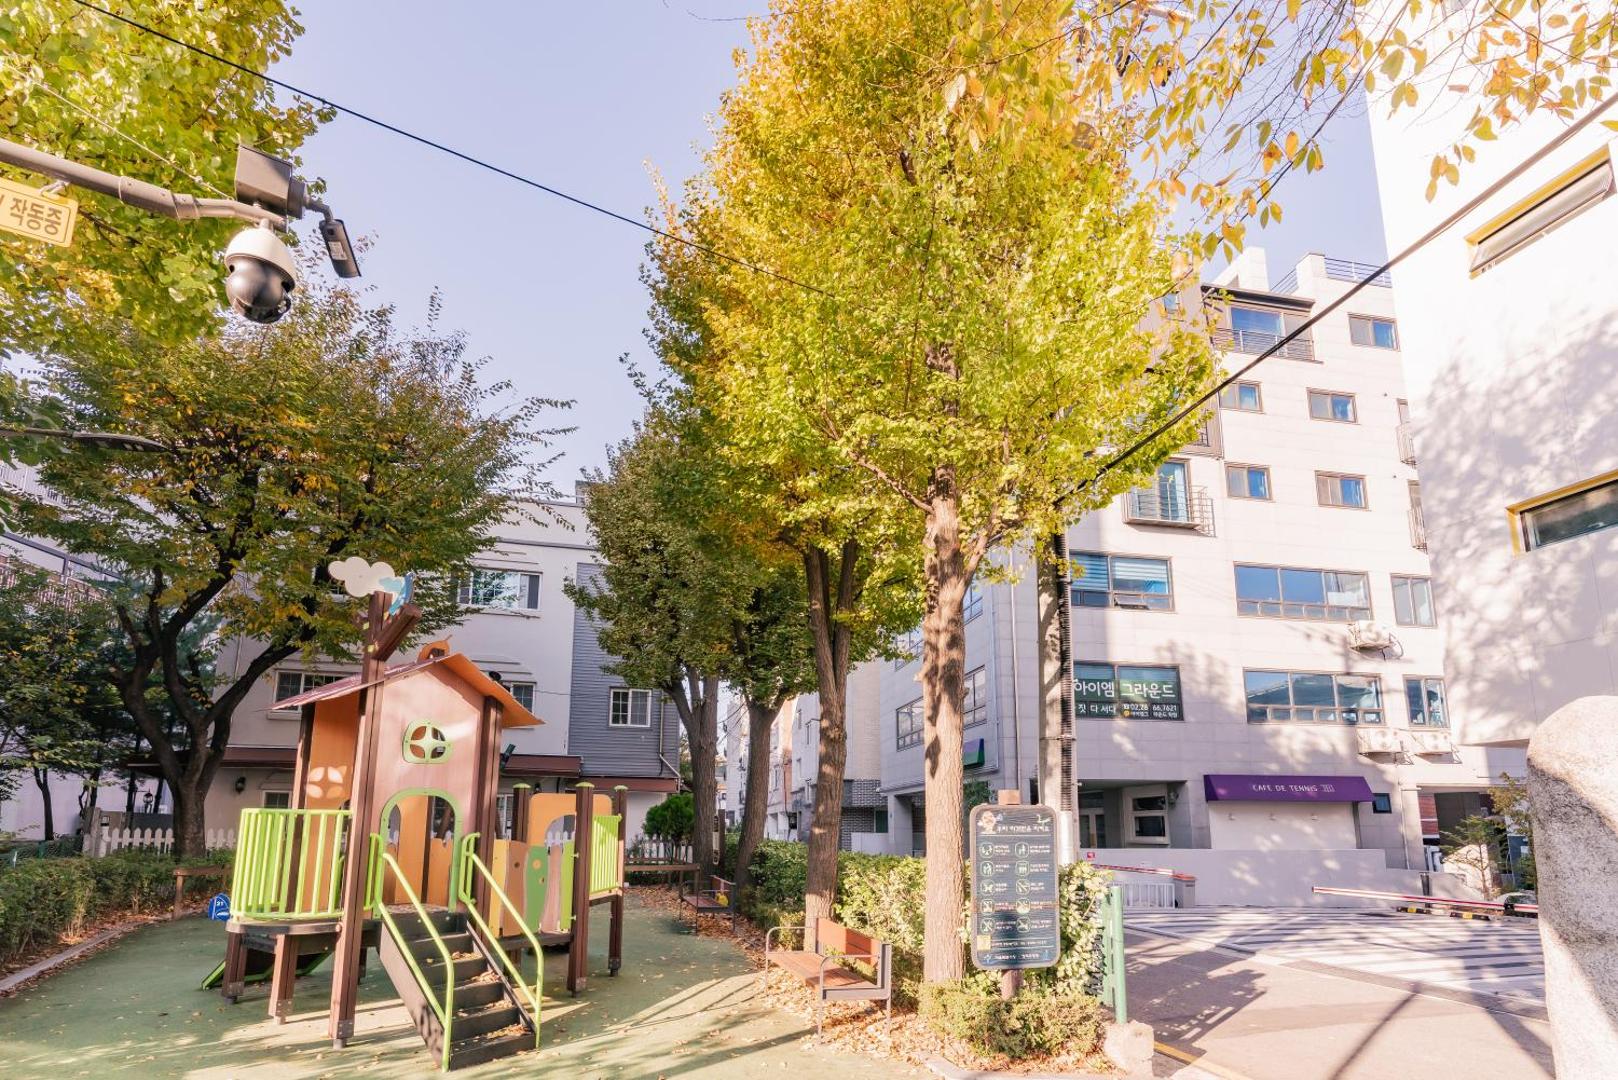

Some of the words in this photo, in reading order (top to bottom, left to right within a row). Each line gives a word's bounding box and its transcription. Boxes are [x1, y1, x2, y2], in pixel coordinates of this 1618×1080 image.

[10, 197, 62, 235] 작동중
[1120, 683, 1176, 698] 그라운드
[1252, 784, 1273, 792] CAFE
[1275, 784, 1287, 792] DE
[1288, 784, 1318, 793] TENNIS
